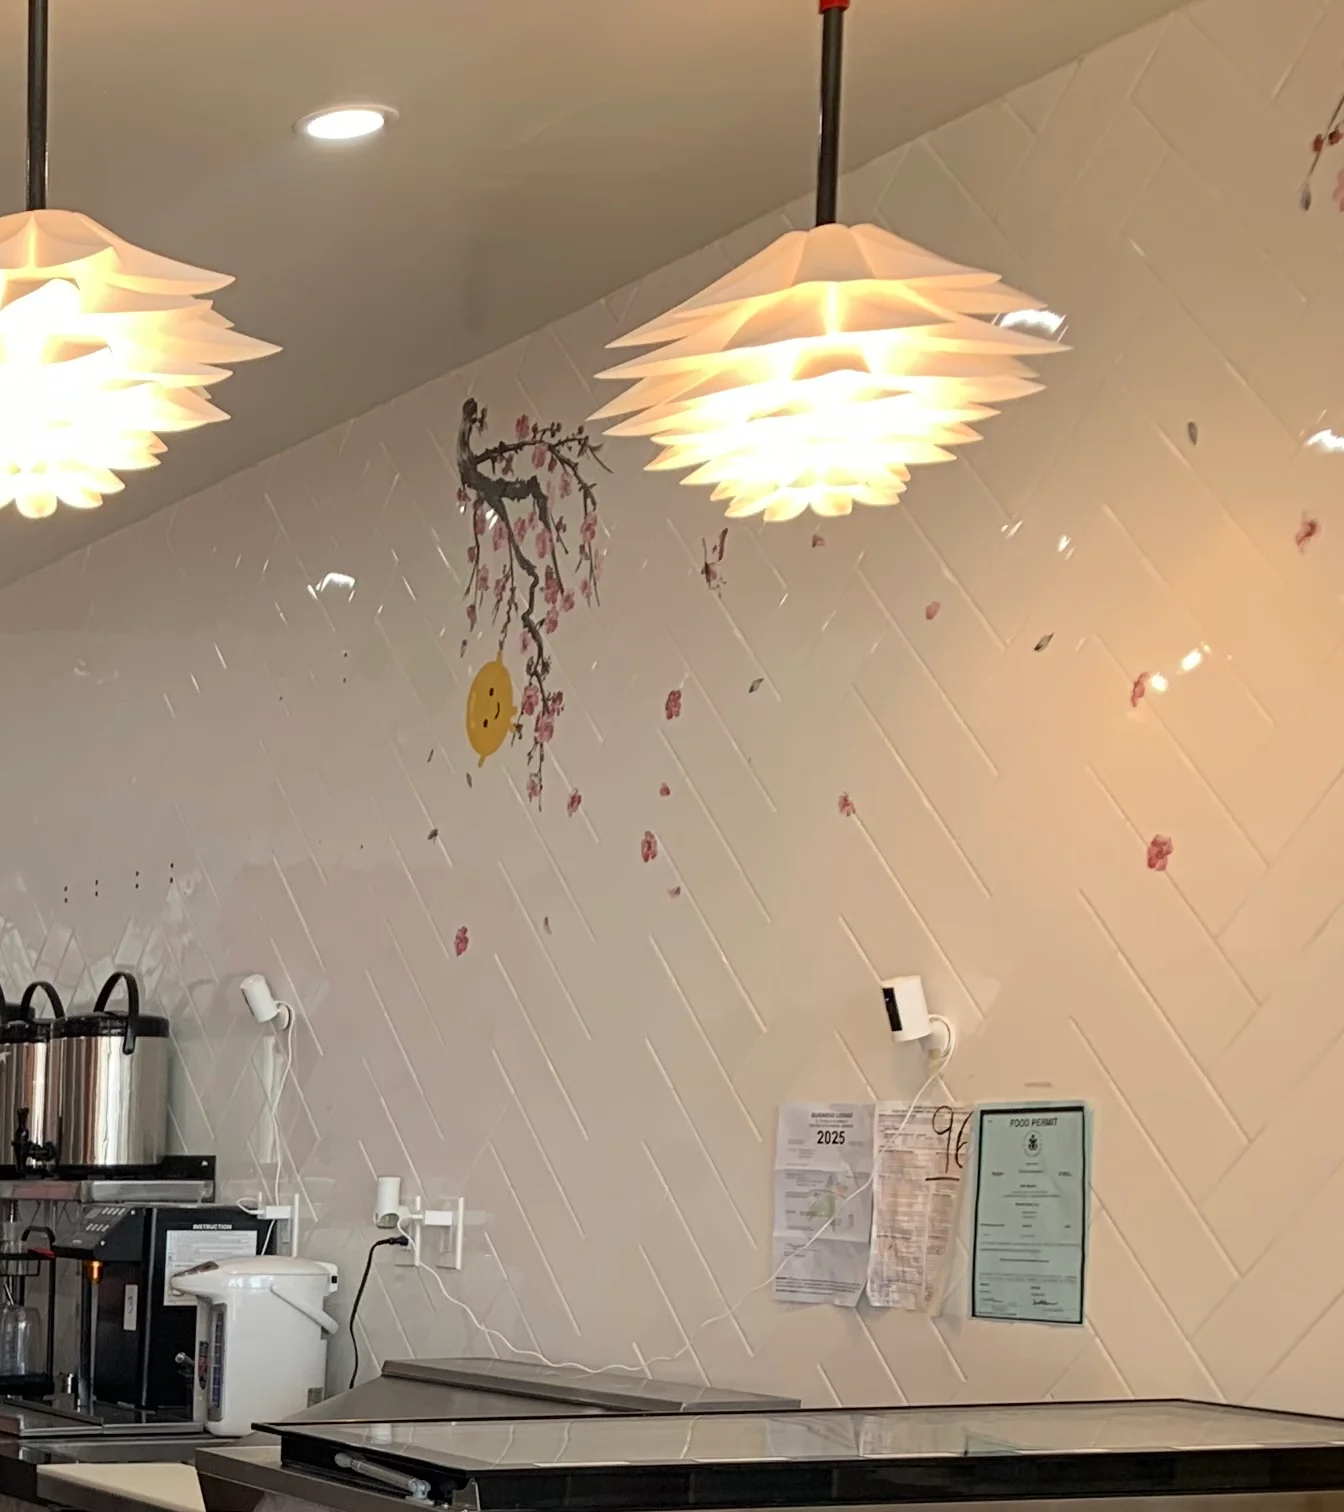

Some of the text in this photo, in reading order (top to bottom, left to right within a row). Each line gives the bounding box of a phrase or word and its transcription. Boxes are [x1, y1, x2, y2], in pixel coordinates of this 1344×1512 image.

[1010, 1117, 1058, 1128] FOOD PERMIT
[816, 1130, 846, 1145] 2025
